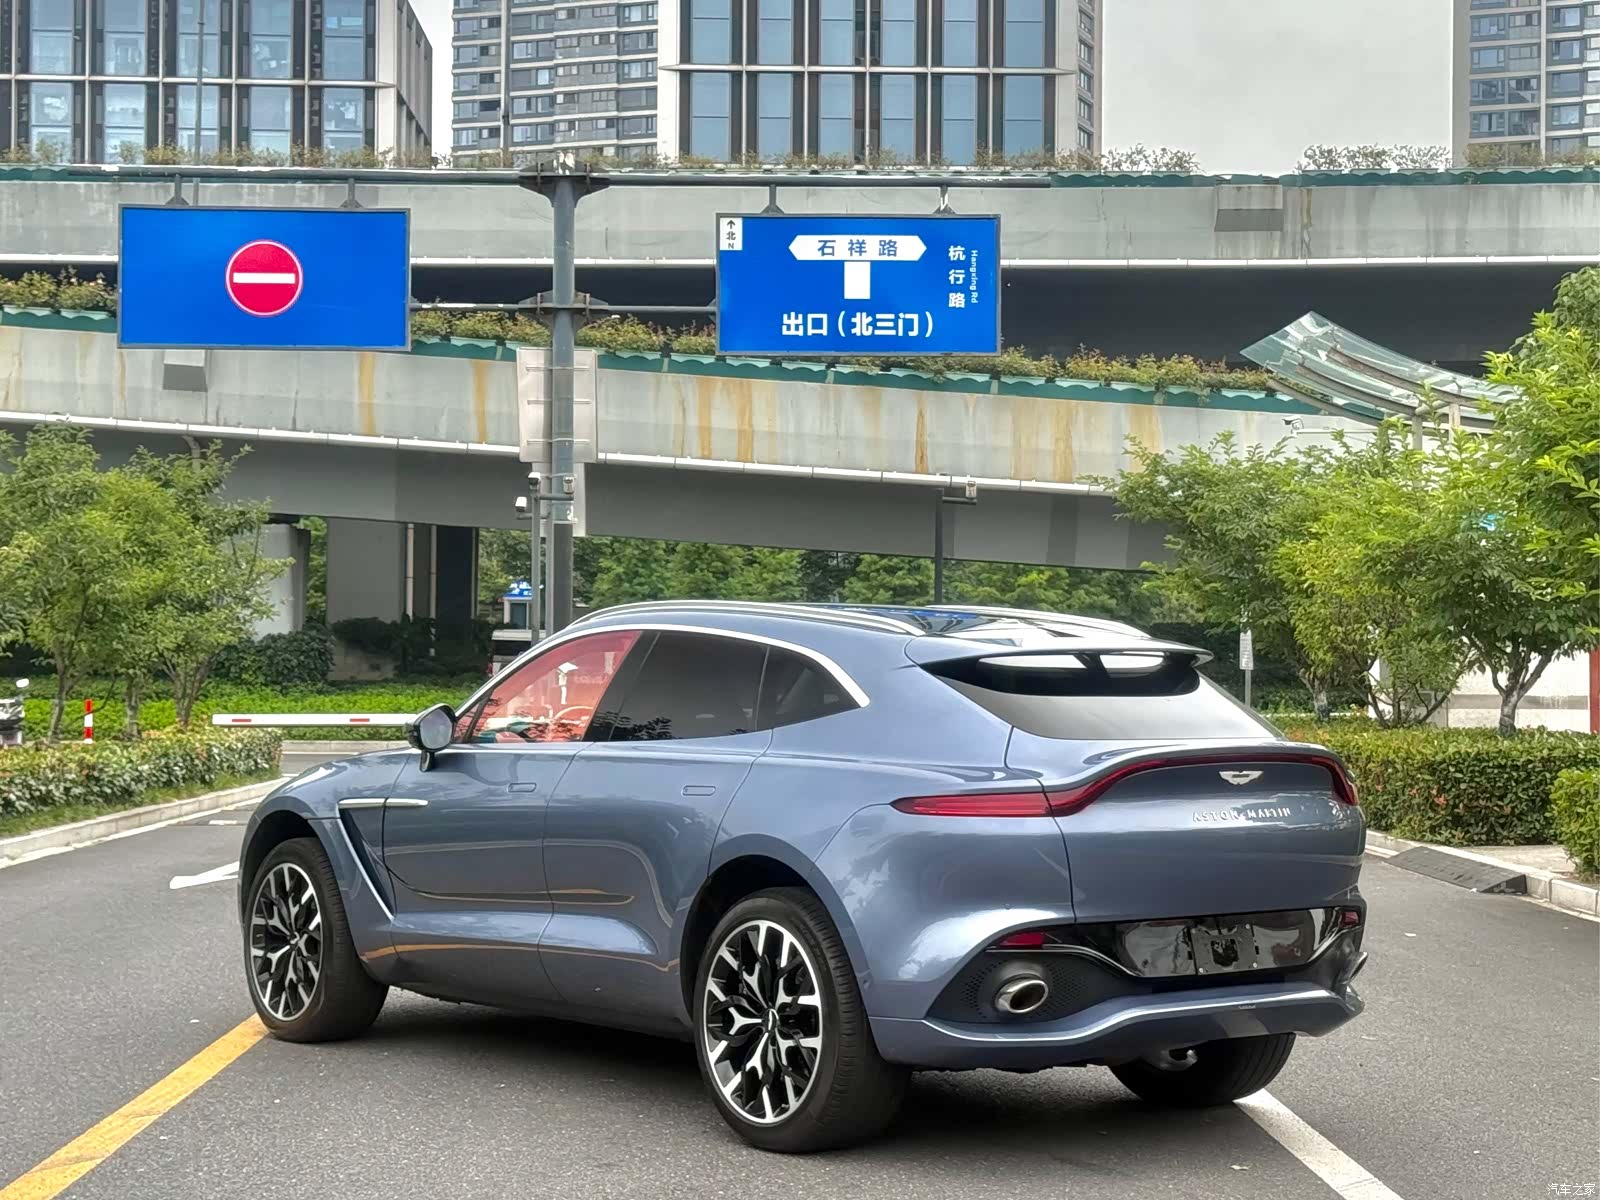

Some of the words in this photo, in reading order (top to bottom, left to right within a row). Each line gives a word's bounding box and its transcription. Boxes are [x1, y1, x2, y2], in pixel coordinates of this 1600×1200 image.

[726, 231, 736, 241] 北
[817, 239, 898, 257] 石祥路
[948, 245, 966, 308] 杭行路
[969, 249, 979, 290] Hangxing
[971, 292, 979, 304] Rd
[1191, 809, 1240, 822] ASTON
